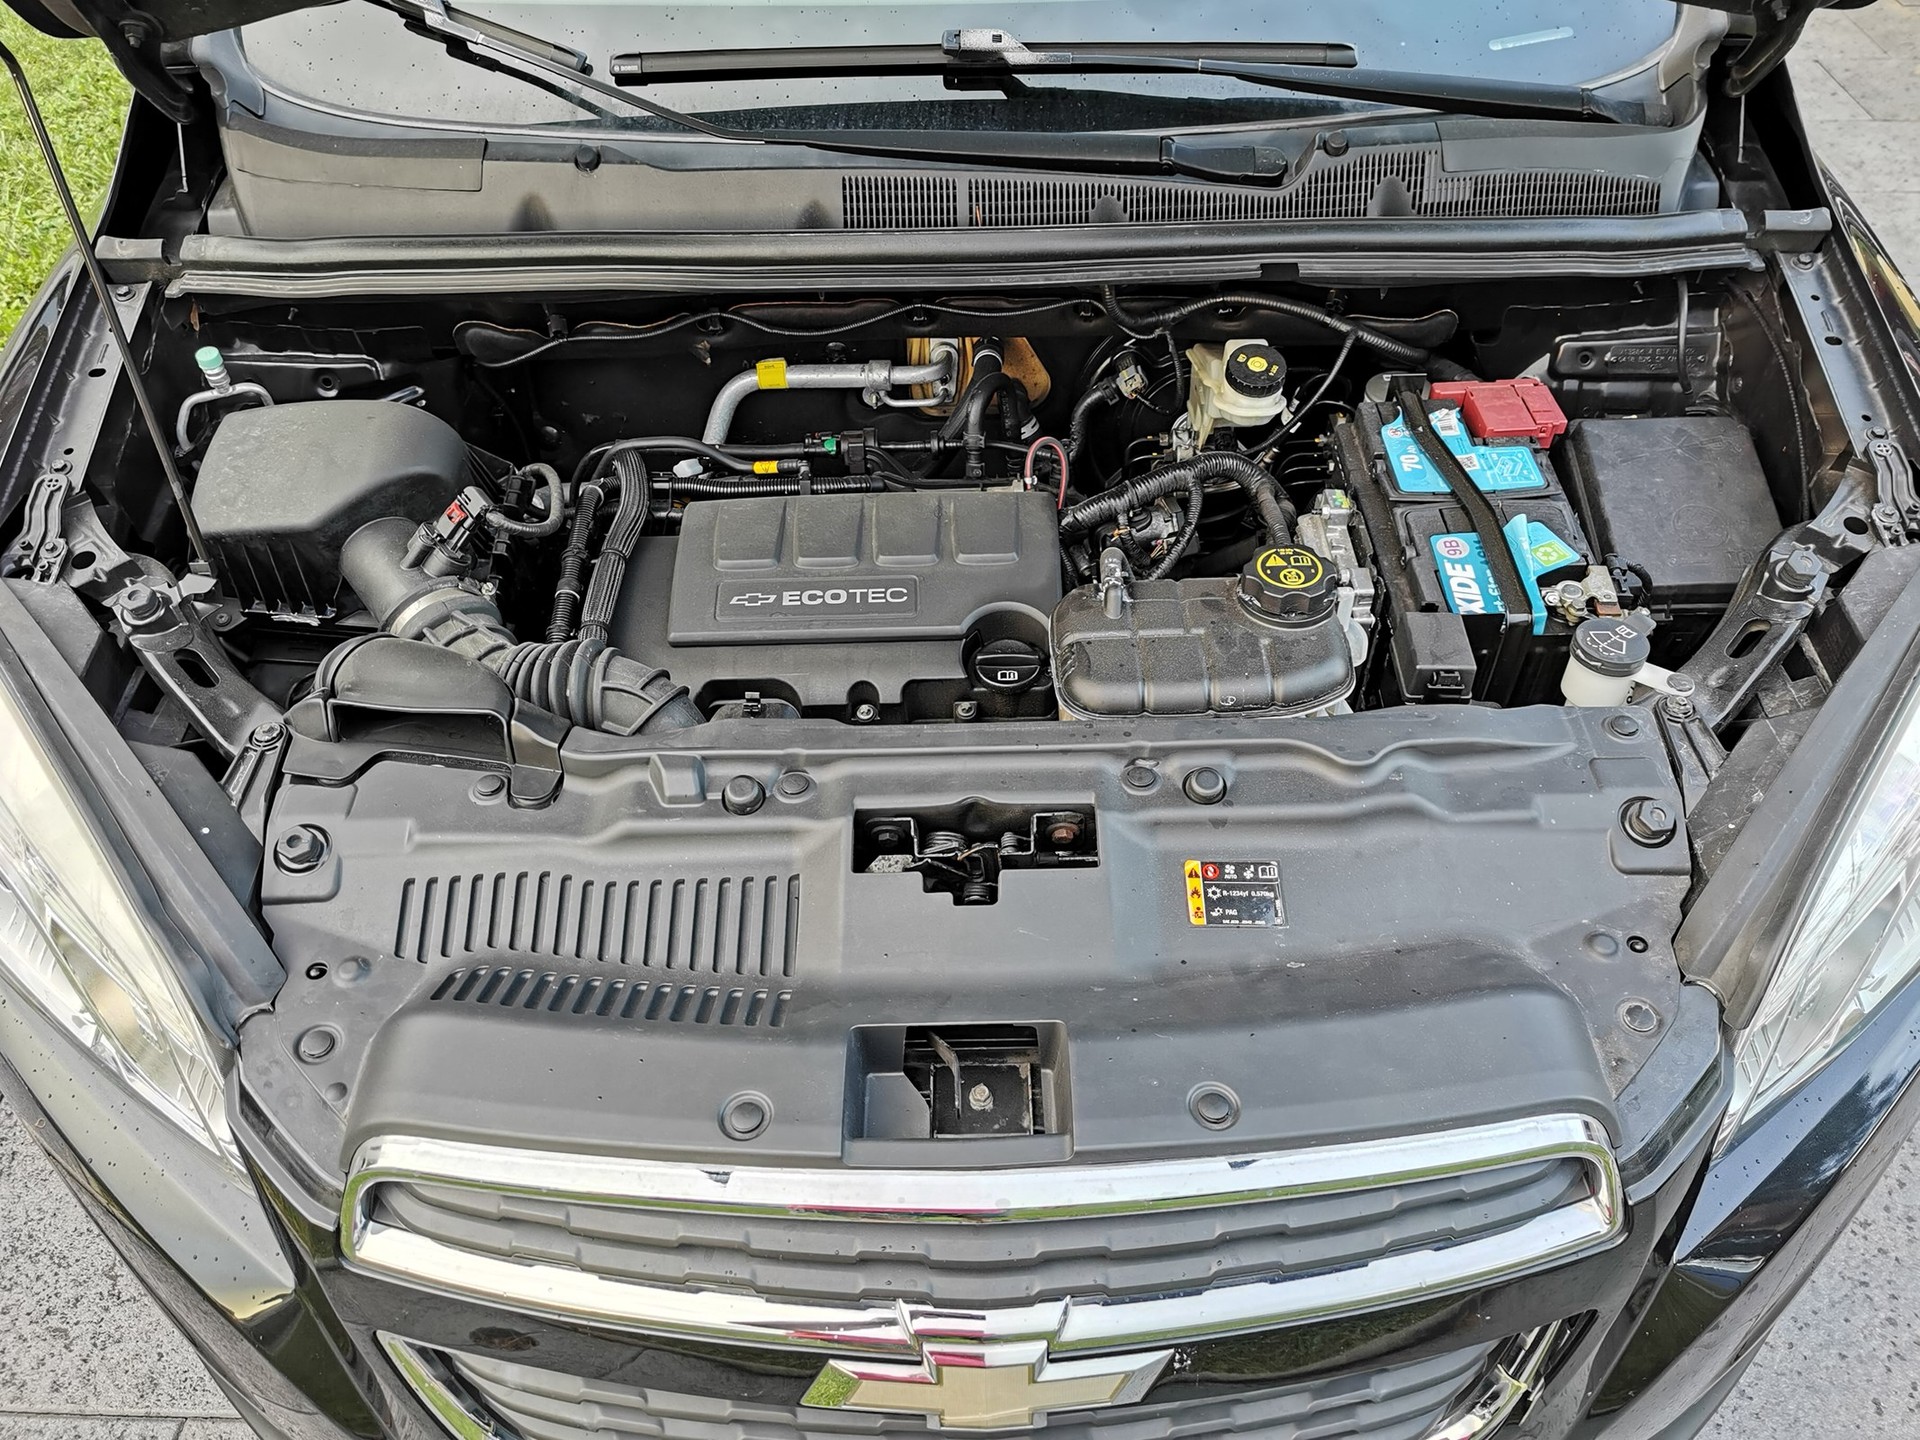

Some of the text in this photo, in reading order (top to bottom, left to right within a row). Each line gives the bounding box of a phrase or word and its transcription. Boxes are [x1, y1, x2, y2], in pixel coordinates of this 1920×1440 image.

[1400, 454, 1424, 472] 70
[1443, 539, 1463, 556] 9B
[1444, 558, 1488, 614] XIDE
[782, 587, 908, 606] ECOTEC
[1225, 908, 1238, 916] PAG
